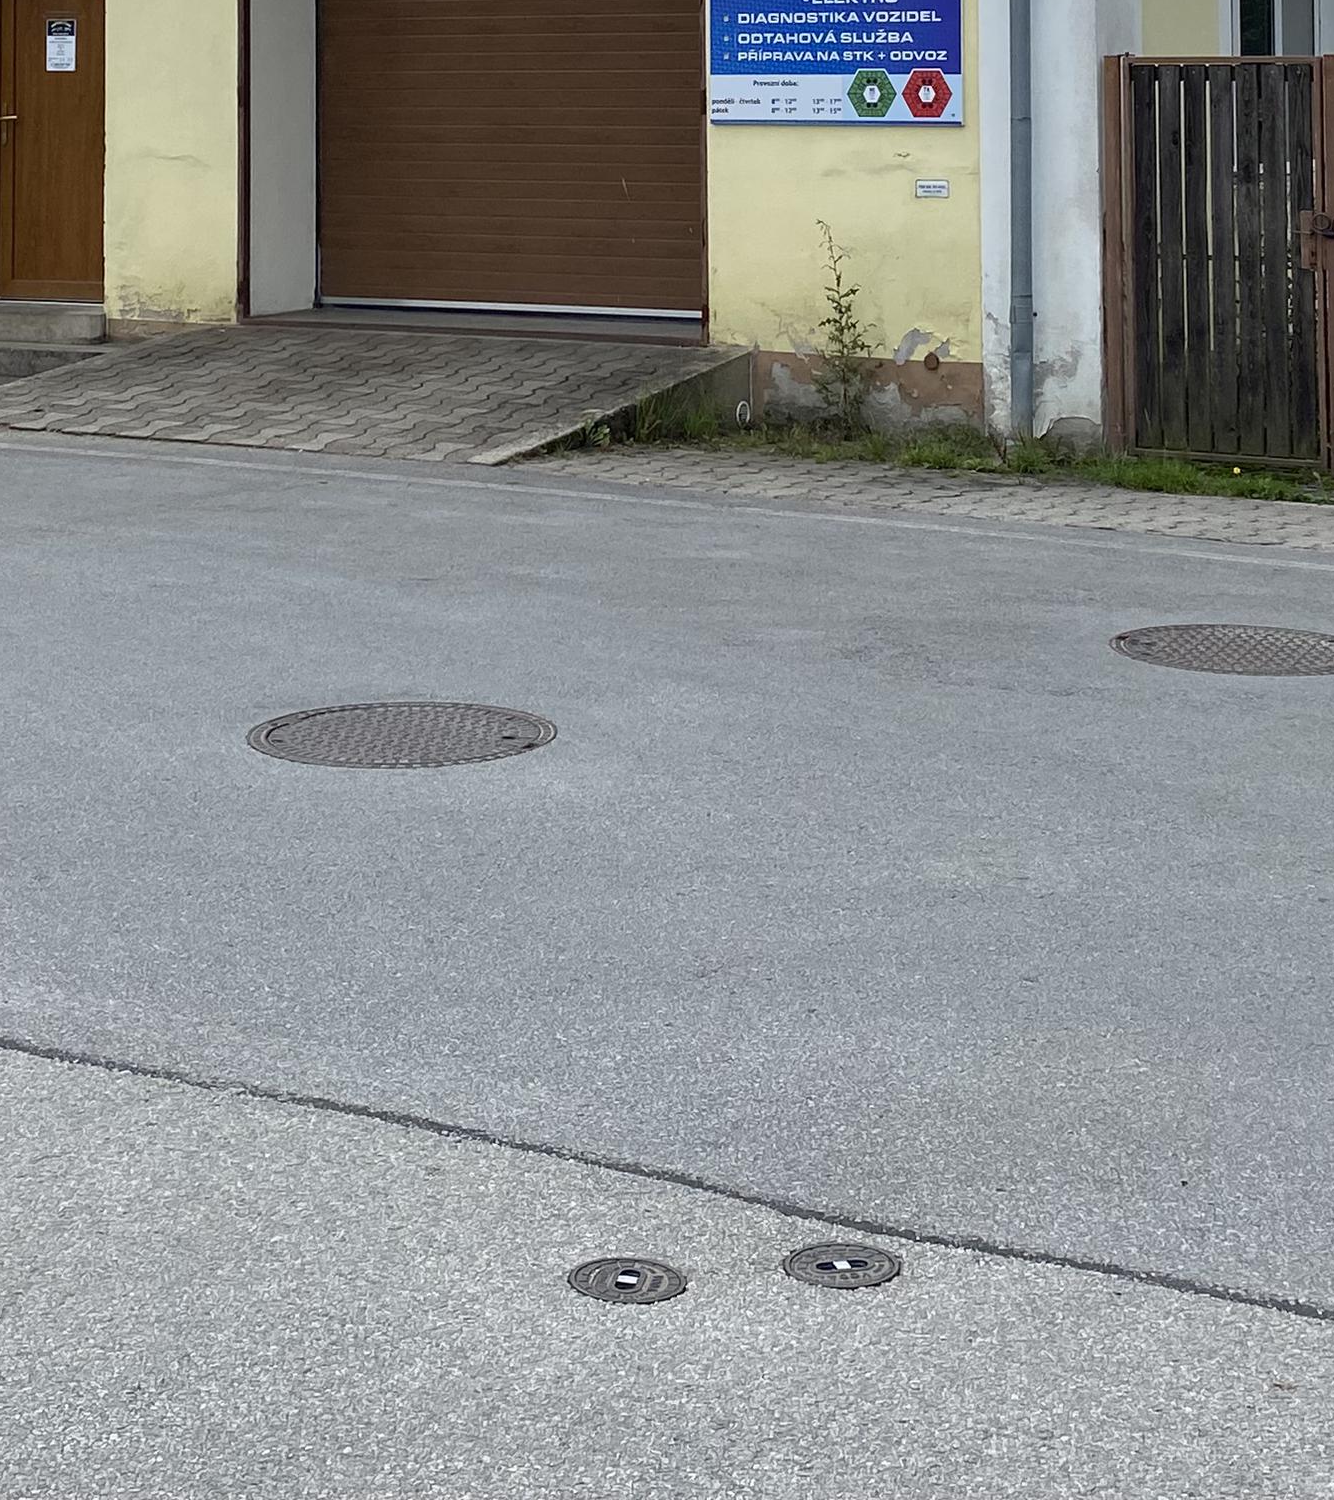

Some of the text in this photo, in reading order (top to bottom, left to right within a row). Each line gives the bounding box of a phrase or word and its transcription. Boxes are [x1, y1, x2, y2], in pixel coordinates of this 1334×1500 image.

[737, 10, 942, 24] DIAGNOSTIKA VOZIDEL
[737, 28, 914, 44] ODTAHOVÁ SLUŽBA
[737, 49, 814, 61] PŘÍPRAVA
[817, 51, 840, 61] NA
[842, 51, 874, 61] STK
[890, 50, 948, 61] ODVOZ
[711, 106, 729, 114] pátek
